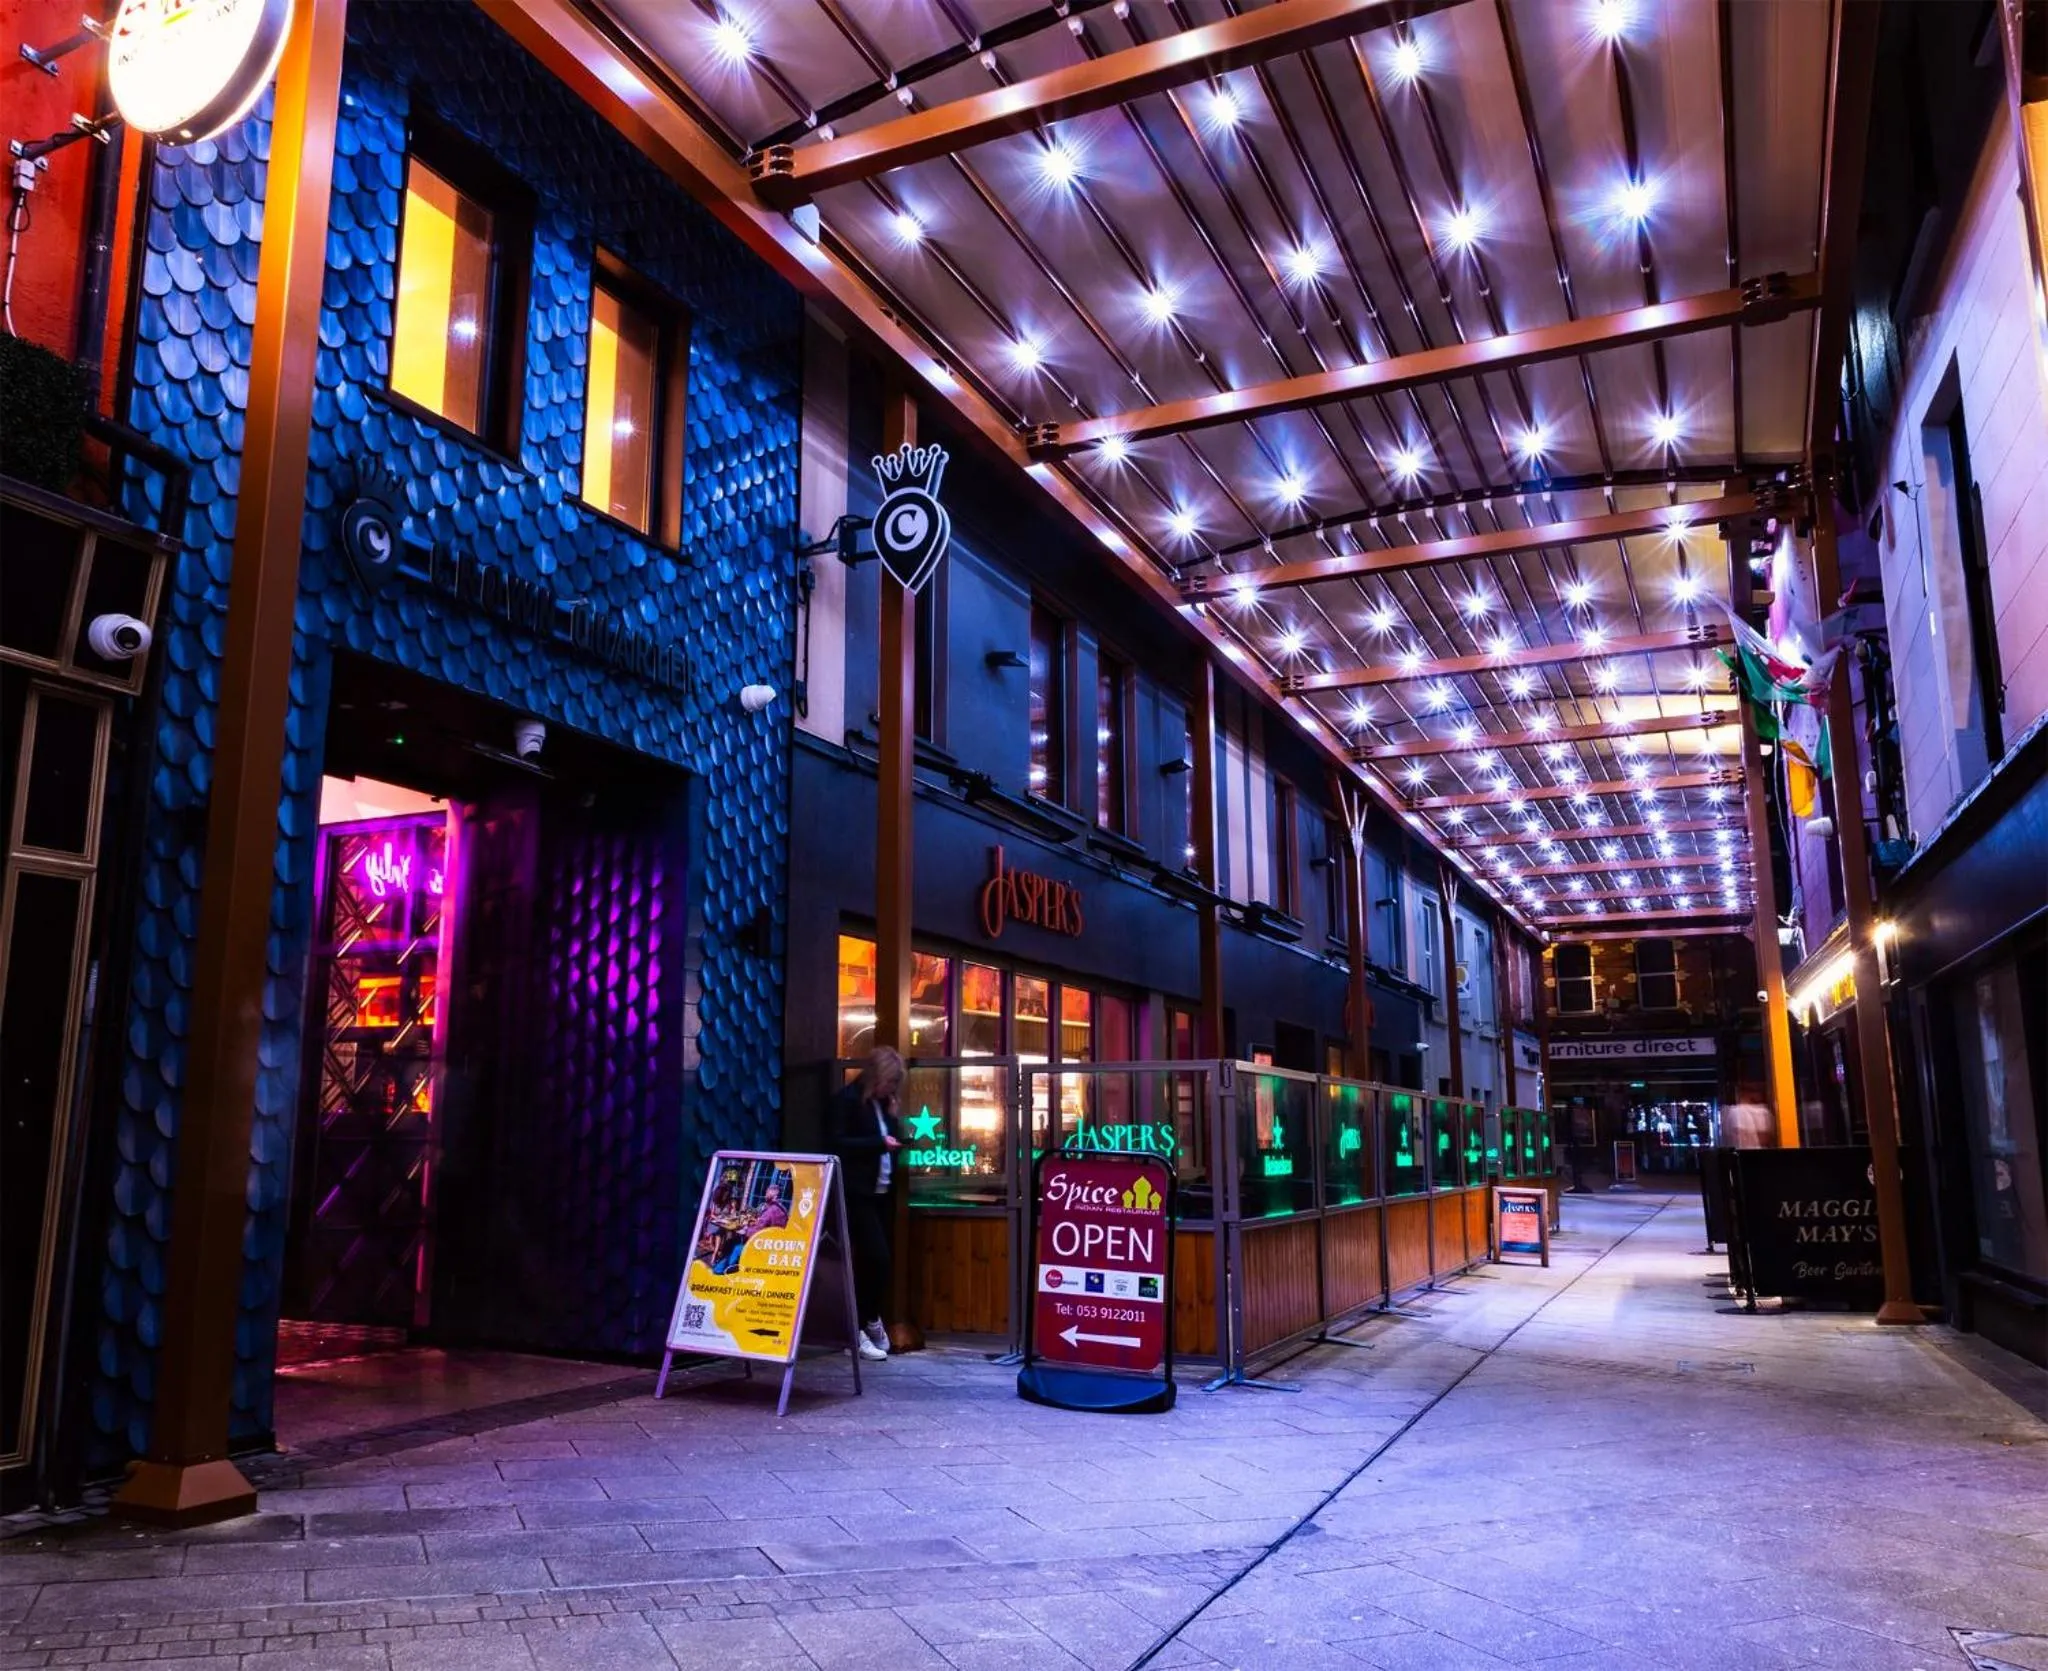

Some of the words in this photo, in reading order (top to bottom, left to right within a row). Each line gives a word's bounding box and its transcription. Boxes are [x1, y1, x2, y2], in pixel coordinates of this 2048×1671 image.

[984, 845, 1084, 938] JASPER'S
[1549, 1041, 1626, 1057] urniture
[1633, 1038, 1696, 1055] direct
[909, 1145, 977, 1167] neken
[1046, 1173, 1118, 1210] Spice
[1075, 1203, 1103, 1212] INDIAN
[1105, 1205, 1160, 1216] RESTAURANT
[1777, 1199, 1880, 1219] MAGGI
[1052, 1221, 1153, 1263] OPEN
[1796, 1225, 1878, 1243] MAY'S
[753, 1238, 806, 1251] CROWN
[768, 1253, 803, 1267] BAR
[1792, 1260, 1828, 1279] Beer
[690, 1283, 732, 1295] BREAKFAST
[736, 1288, 761, 1298] LUNCH
[766, 1290, 796, 1300] DINNER
[1055, 1303, 1073, 1316] Tel:
[1076, 1304, 1098, 1318] 053
[1100, 1307, 1146, 1323] 9122011
